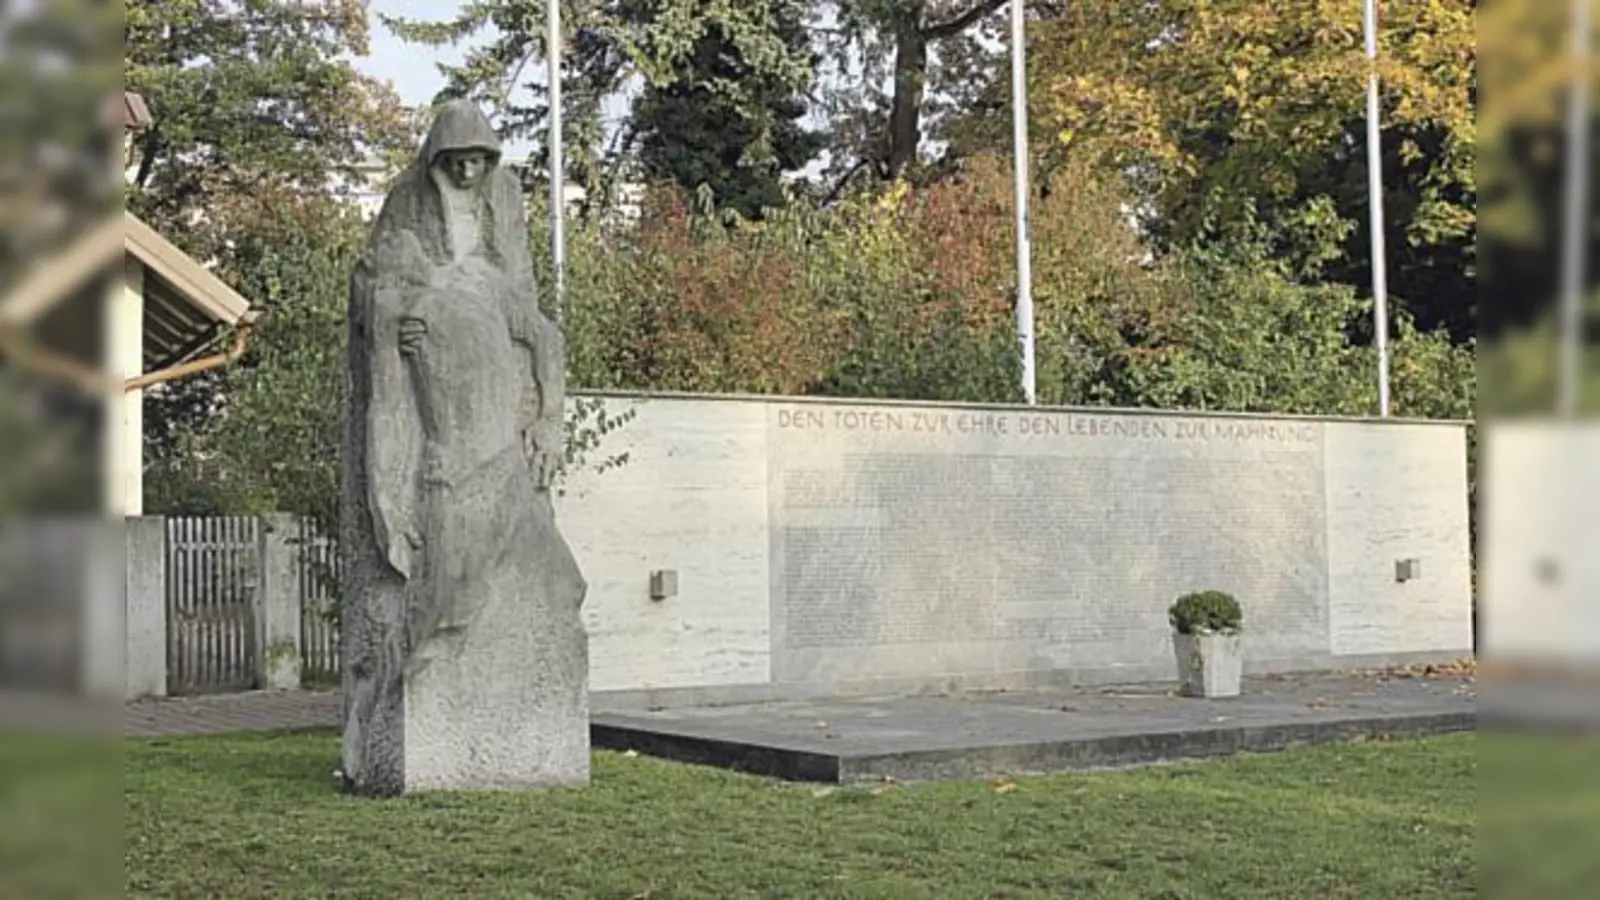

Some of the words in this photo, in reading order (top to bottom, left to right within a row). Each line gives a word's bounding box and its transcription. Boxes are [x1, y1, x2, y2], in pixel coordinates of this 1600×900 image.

[778, 409, 824, 429] DEN
[834, 411, 903, 431] TOTEN
[910, 412, 951, 435] ZUR
[956, 413, 1008, 436] EHRE
[1019, 415, 1060, 435] DEN
[1067, 415, 1168, 439] LEBENDEN
[1176, 420, 1208, 443] ZUR
